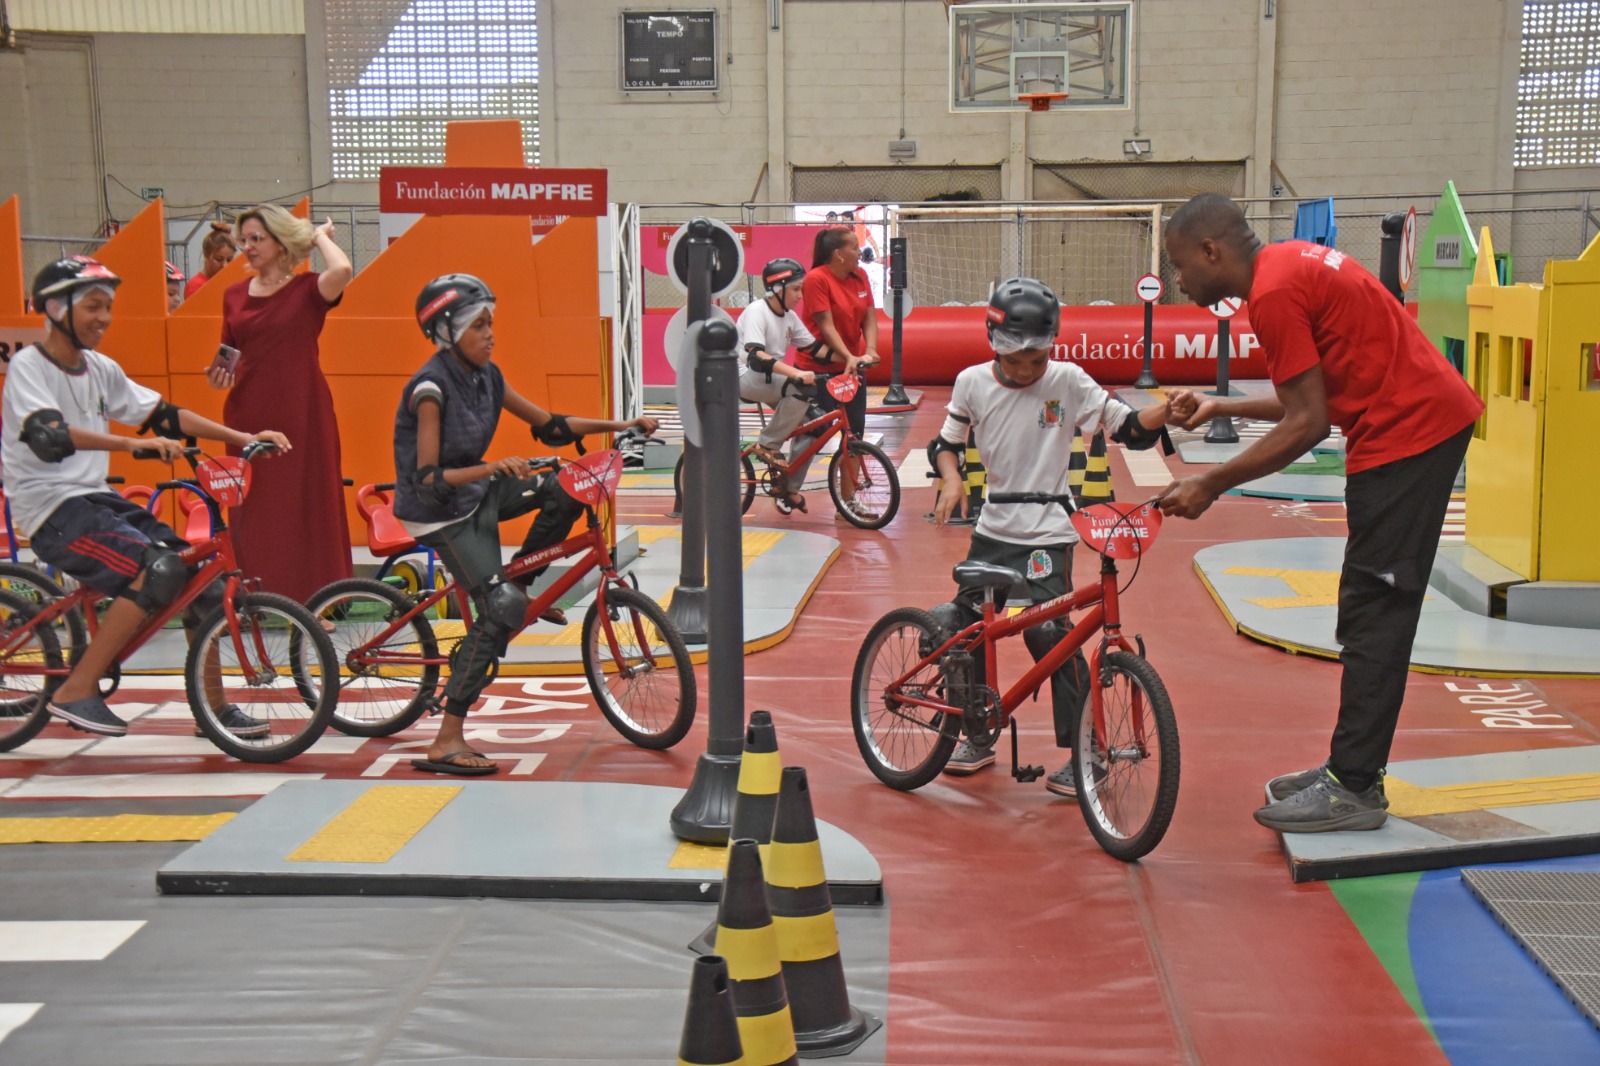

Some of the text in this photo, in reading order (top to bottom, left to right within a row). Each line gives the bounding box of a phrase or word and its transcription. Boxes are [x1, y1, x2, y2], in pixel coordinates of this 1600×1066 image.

[396, 181, 593, 201] Fundación MAPFRE
[1436, 242, 1459, 260] MERCADO
[1053, 333, 1261, 360] ndación MAP
[1091, 514, 1144, 526] Fundación
[1090, 527, 1149, 539] MAPFRE
[524, 545, 563, 566] MAPFRE
[1040, 590, 1075, 611] MAPFRE
[1444, 681, 1574, 729] PARE
